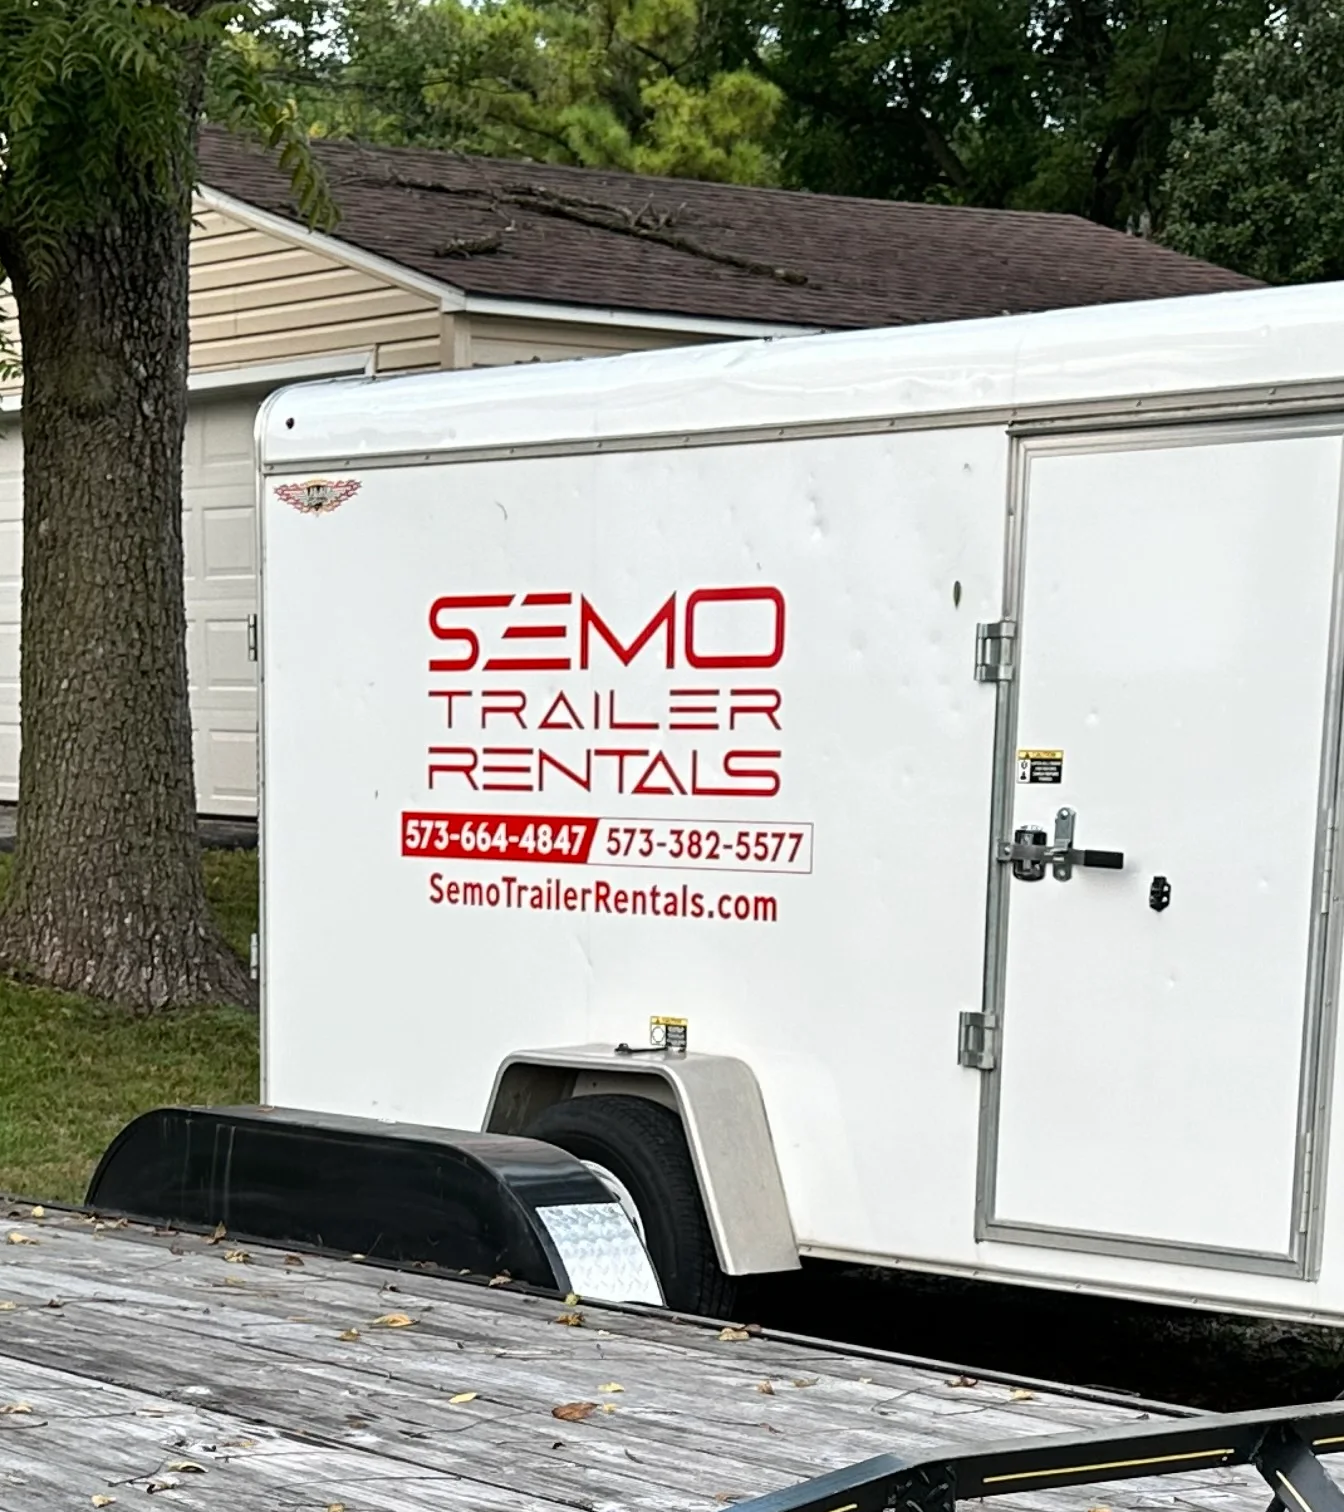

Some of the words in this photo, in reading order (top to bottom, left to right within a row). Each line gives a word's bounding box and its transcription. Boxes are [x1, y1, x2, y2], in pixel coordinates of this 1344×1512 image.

[429, 586, 785, 672] SEMO
[429, 688, 782, 730] TRAILER
[428, 746, 782, 797] RENTALS
[404, 818, 588, 857] 573-664-4847
[606, 828, 804, 863] 573-382-5577
[430, 873, 777, 922] SemoTrailerRentals.com
